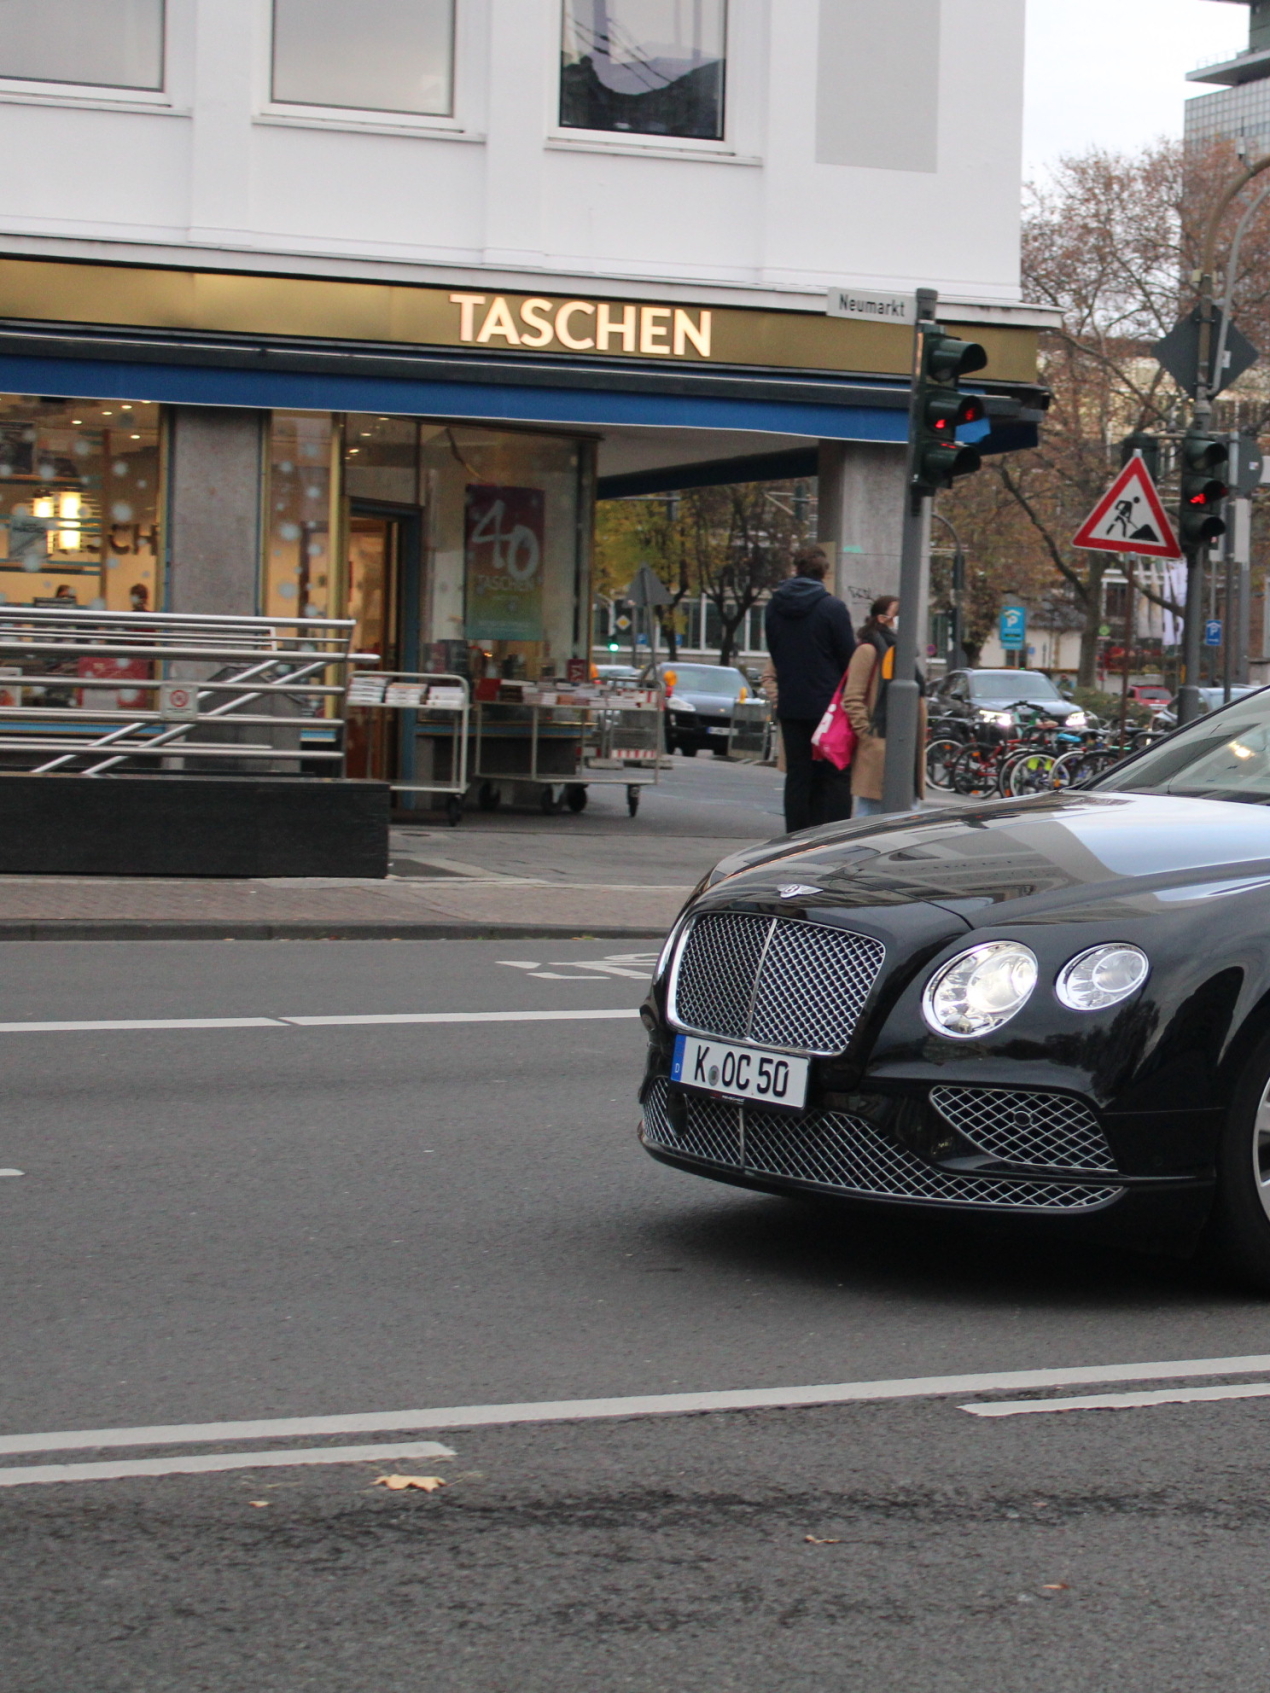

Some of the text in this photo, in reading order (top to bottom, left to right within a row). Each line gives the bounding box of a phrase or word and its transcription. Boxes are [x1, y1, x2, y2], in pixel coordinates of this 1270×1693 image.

[450, 294, 712, 357] TASCHEN
[839, 293, 905, 317] Neumarkt
[471, 499, 540, 581] 40
[694, 1044, 789, 1098] K OC 50
